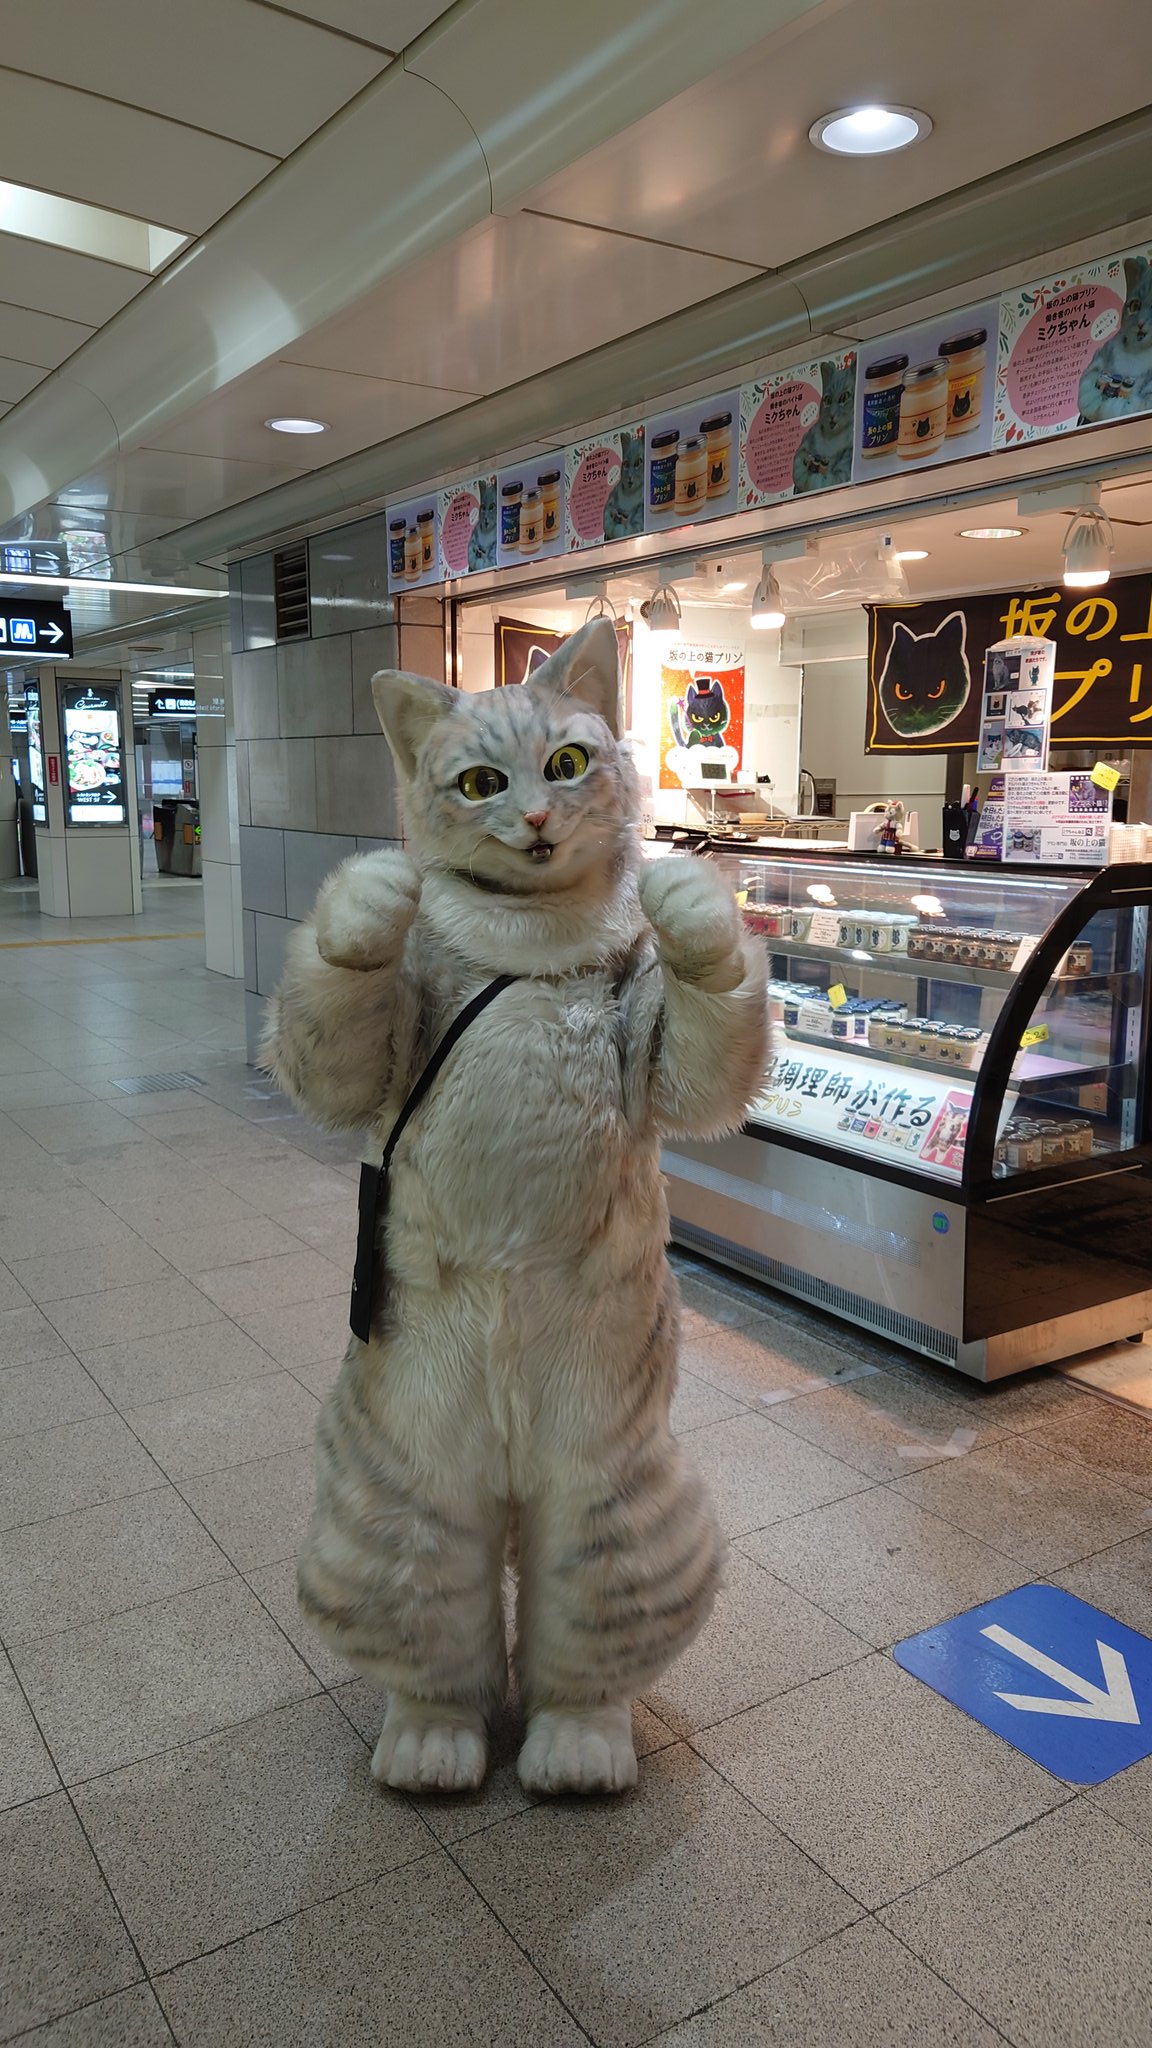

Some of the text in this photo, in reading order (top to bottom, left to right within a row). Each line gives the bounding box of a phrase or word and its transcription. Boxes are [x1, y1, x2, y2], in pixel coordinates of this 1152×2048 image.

[1045, 286, 1099, 310] 坂の上の猫プリン
[1045, 300, 1096, 323] 働き者のバイト猫
[1037, 313, 1092, 341] ミクちゃん
[764, 404, 801, 425] ミクちゃん
[868, 433, 890, 448] プリン
[582, 466, 608, 483] ミクちゃん
[668, 650, 744, 663] 坂の上の猫プリン
[1070, 838, 1106, 848] 坂の上の猫
[767, 1057, 937, 1127] 調理師が作る
